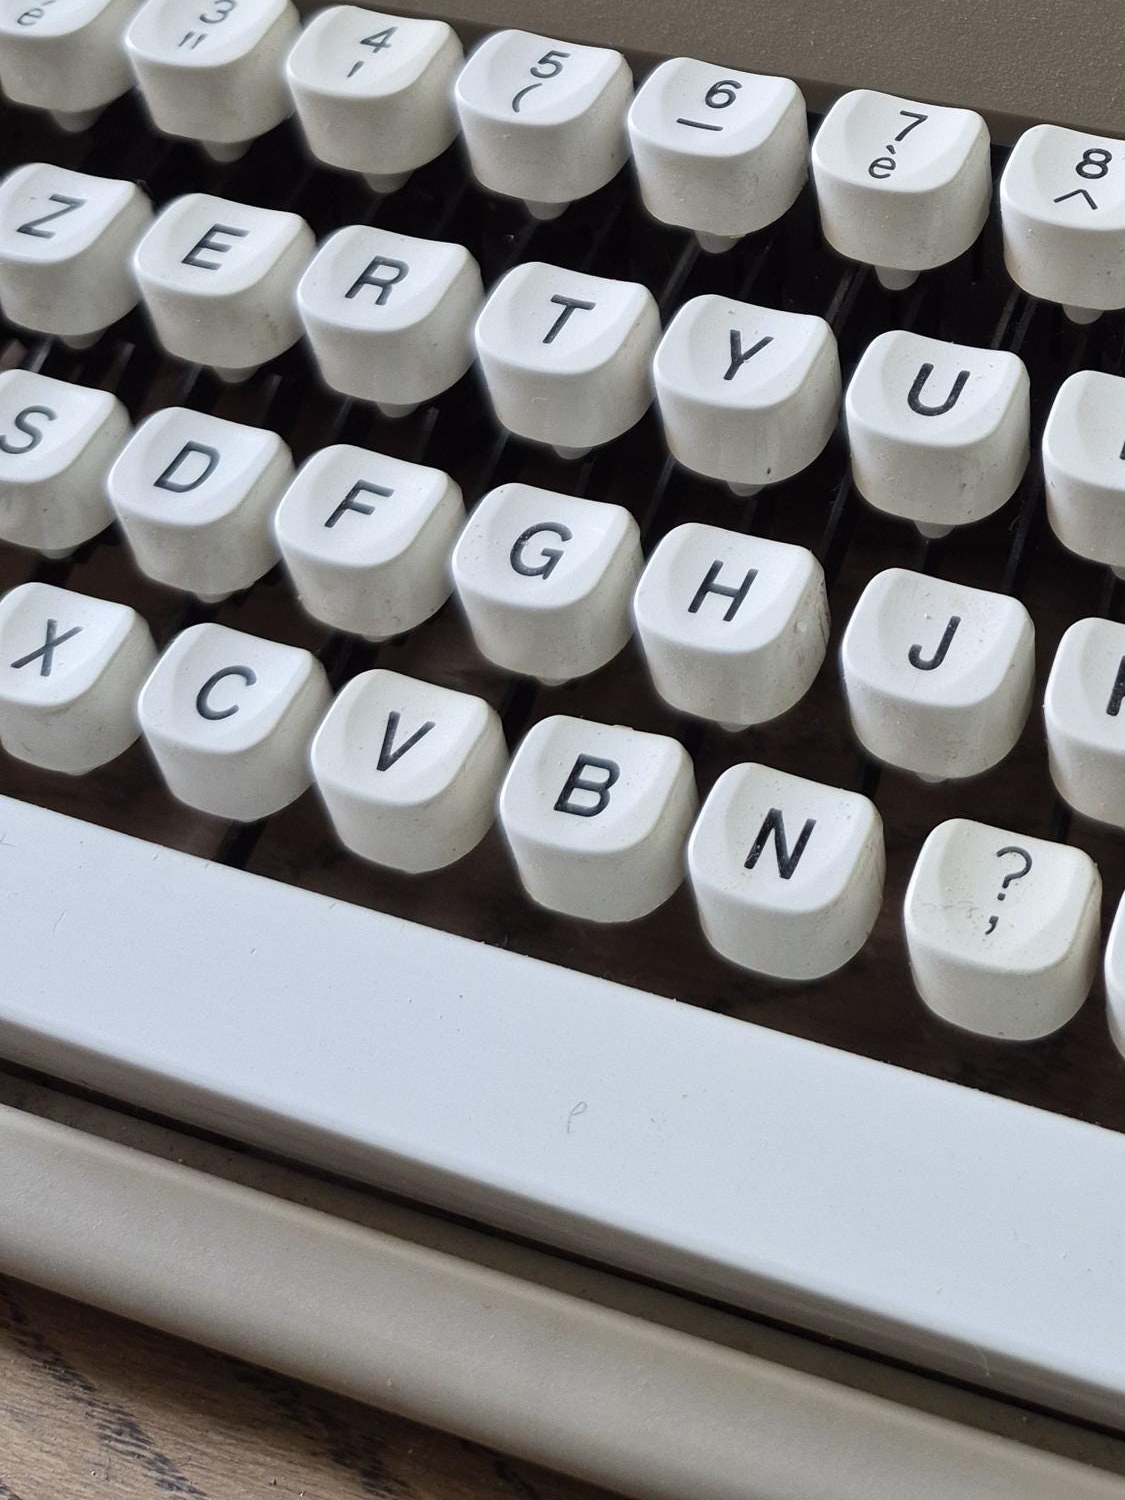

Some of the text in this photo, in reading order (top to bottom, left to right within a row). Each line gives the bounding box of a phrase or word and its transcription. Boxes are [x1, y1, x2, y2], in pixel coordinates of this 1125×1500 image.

[359, 26, 396, 54] 4
[529, 49, 570, 79] 5
[704, 79, 743, 110] 6
[894, 110, 929, 142] 7
[867, 144, 897, 180] è
[1075, 148, 1113, 180] 8
[15, 193, 84, 239] Z
[180, 223, 247, 271] E
[344, 255, 408, 306] R
[542, 294, 596, 345] T
[723, 329, 774, 381] Y
[906, 362, 971, 417] U
[0, 405, 56, 455] S
[152, 440, 219, 494] D
[323, 479, 393, 529] F
[509, 522, 572, 581] G
[687, 560, 759, 622] H
[9, 618, 82, 677] X
[907, 615, 962, 671] J
[195, 665, 256, 721] C
[375, 711, 435, 772] V
[553, 753, 620, 818] B
[743, 807, 817, 880] N
[995, 846, 1033, 902] ?
